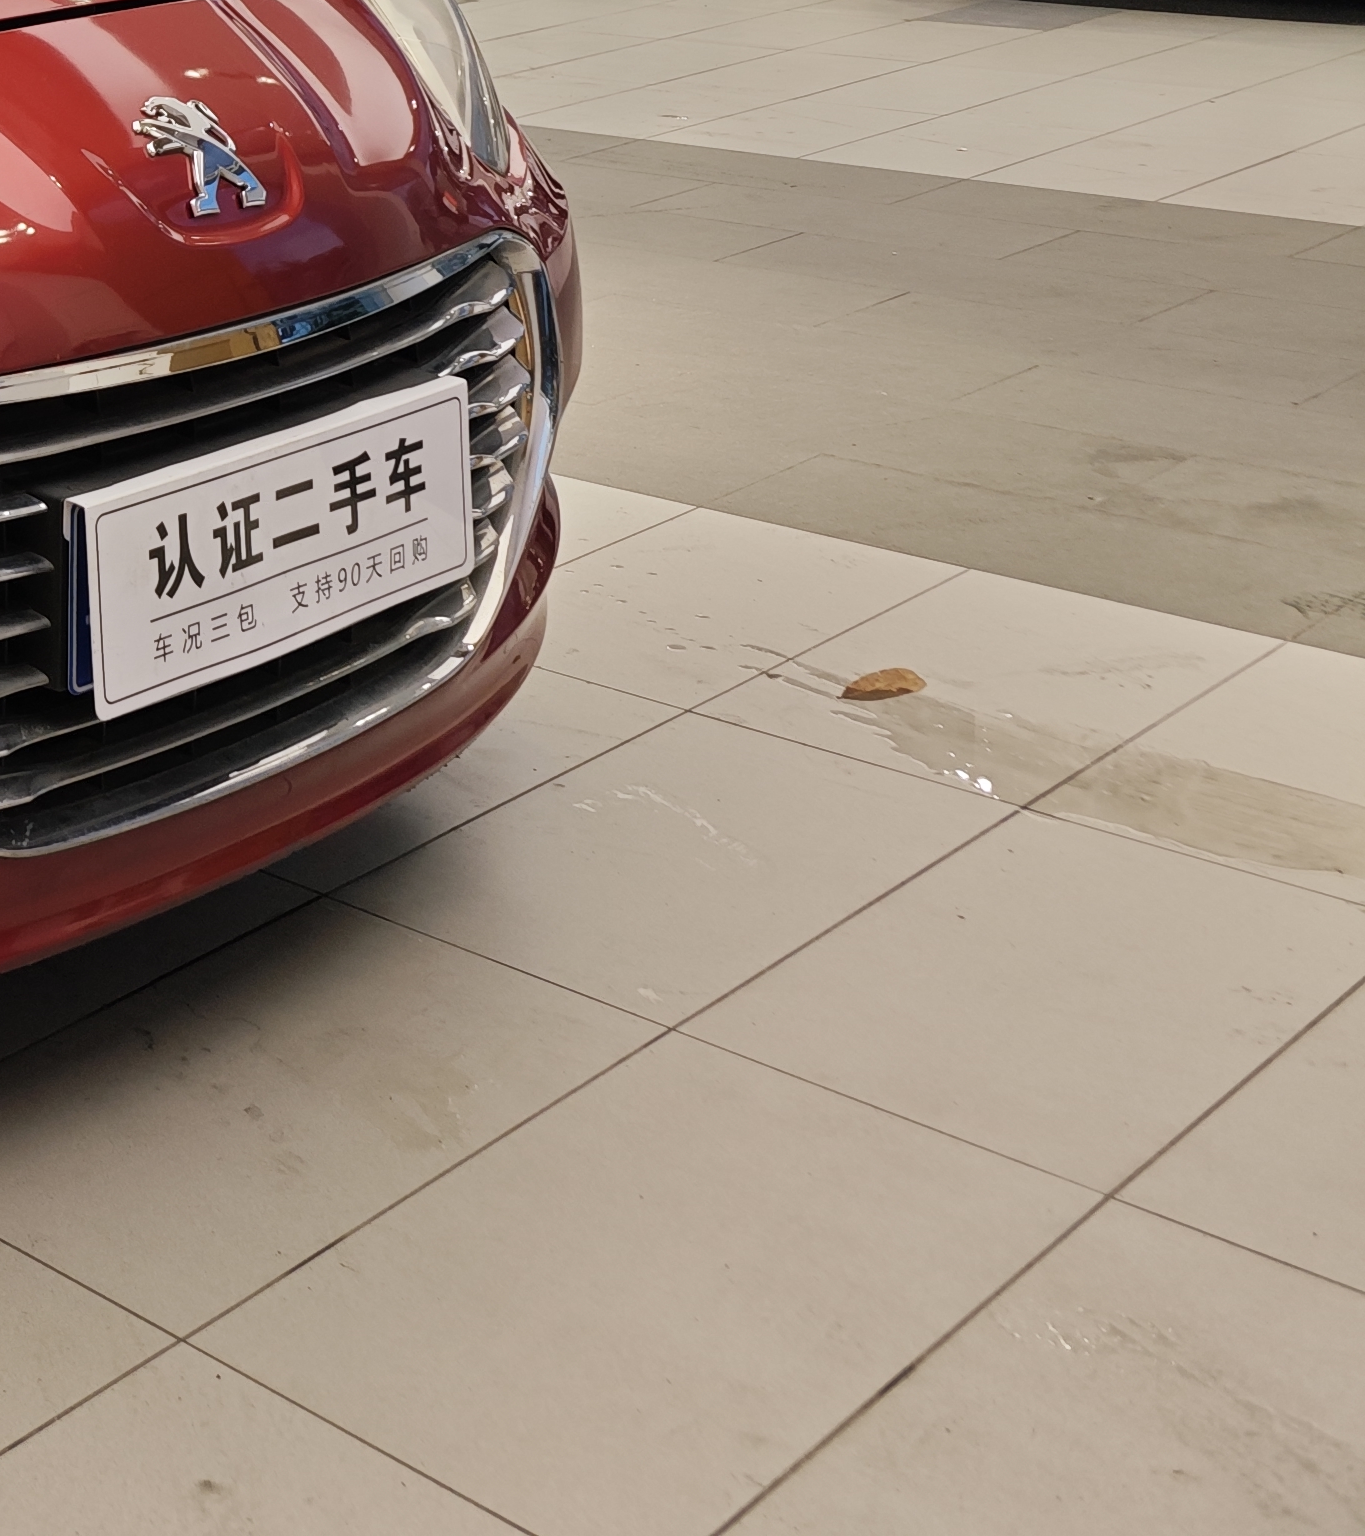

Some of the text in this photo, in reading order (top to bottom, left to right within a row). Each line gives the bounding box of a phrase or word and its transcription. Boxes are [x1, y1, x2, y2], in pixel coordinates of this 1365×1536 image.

[148, 437, 427, 600] 认证二手车
[153, 534, 429, 663] 车况三包 支持90天回购
